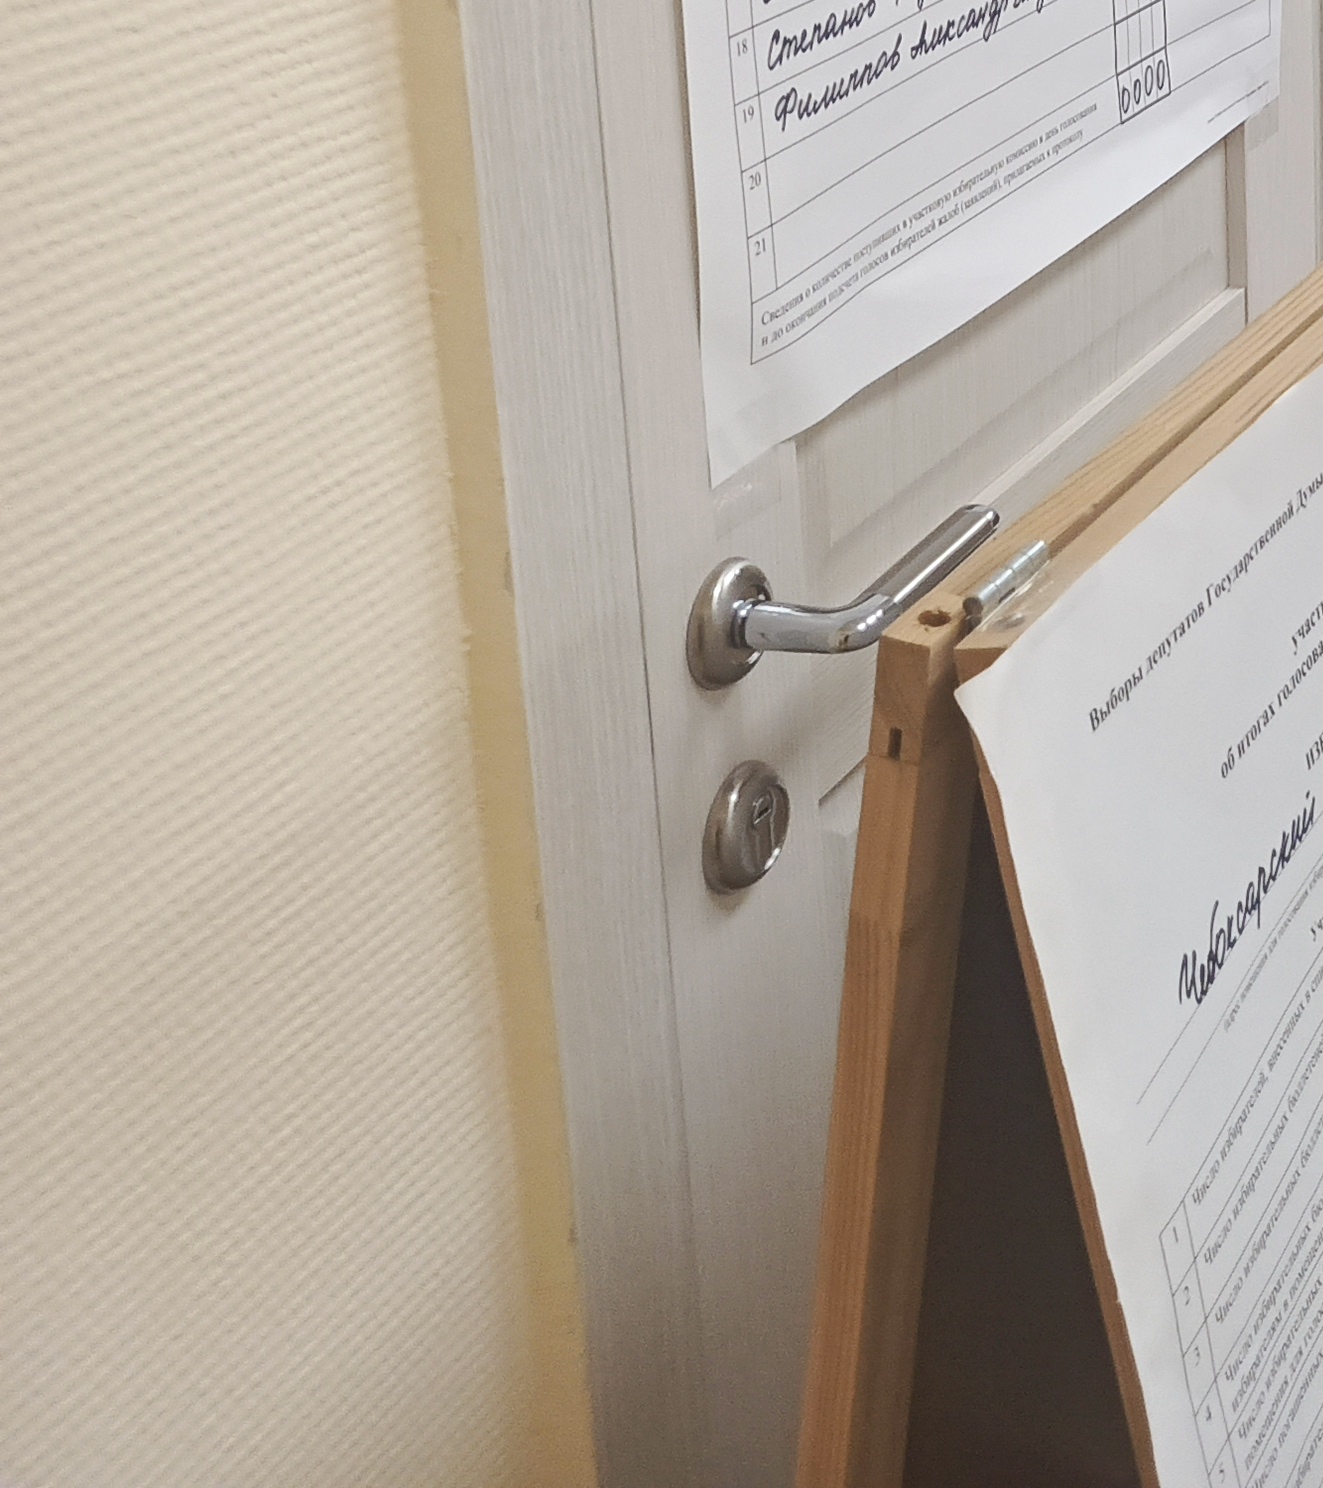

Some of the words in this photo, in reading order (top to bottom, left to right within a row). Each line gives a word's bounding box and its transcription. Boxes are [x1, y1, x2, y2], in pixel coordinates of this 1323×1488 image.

[736, 37, 749, 55] 18
[741, 105, 756, 124] 19
[774, 32, 902, 132] Филиппов
[748, 171, 763, 191] 20
[754, 238, 768, 256] 21
[1088, 666, 1143, 731] Выборы
[1146, 600, 1205, 674] депутатов
[1205, 499, 1294, 607] Государственной
[1295, 472, 1323, 513] Думы
[1220, 746, 1235, 778] об
[1236, 703, 1275, 758] итогах
[1180, 791, 1316, 1005] Чебоксарский
